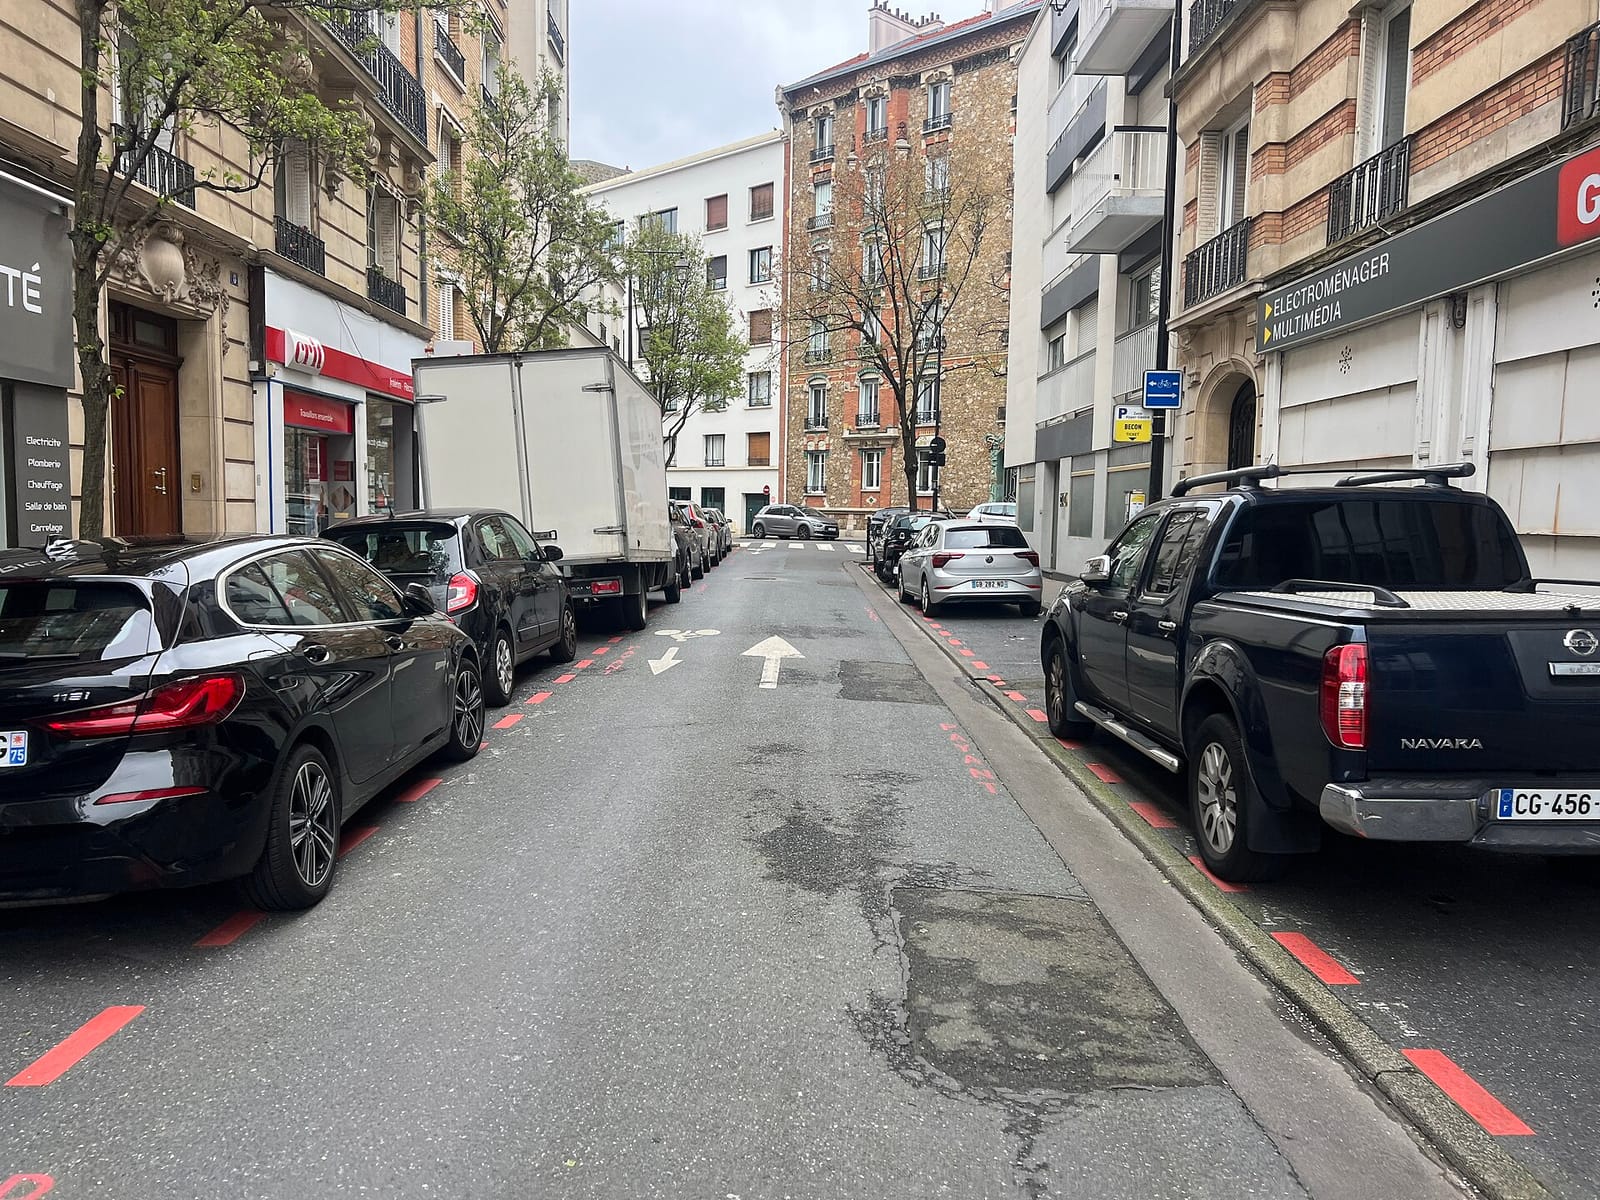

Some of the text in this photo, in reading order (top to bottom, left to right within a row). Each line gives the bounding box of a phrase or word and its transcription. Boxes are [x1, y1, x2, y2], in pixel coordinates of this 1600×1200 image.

[1273, 252, 1390, 317] ELECTROMÉNAGER
[1272, 300, 1342, 341] MULTIMÉDIA
[1118, 408, 1128, 419] P
[27, 458, 61, 468] Plomberie
[27, 480, 63, 492] Chauffage
[25, 502, 67, 511] Salle de bain
[30, 524, 63, 533] Carrelage
[1401, 738, 1484, 750] NAVARA
[11, 749, 25, 761] 75
